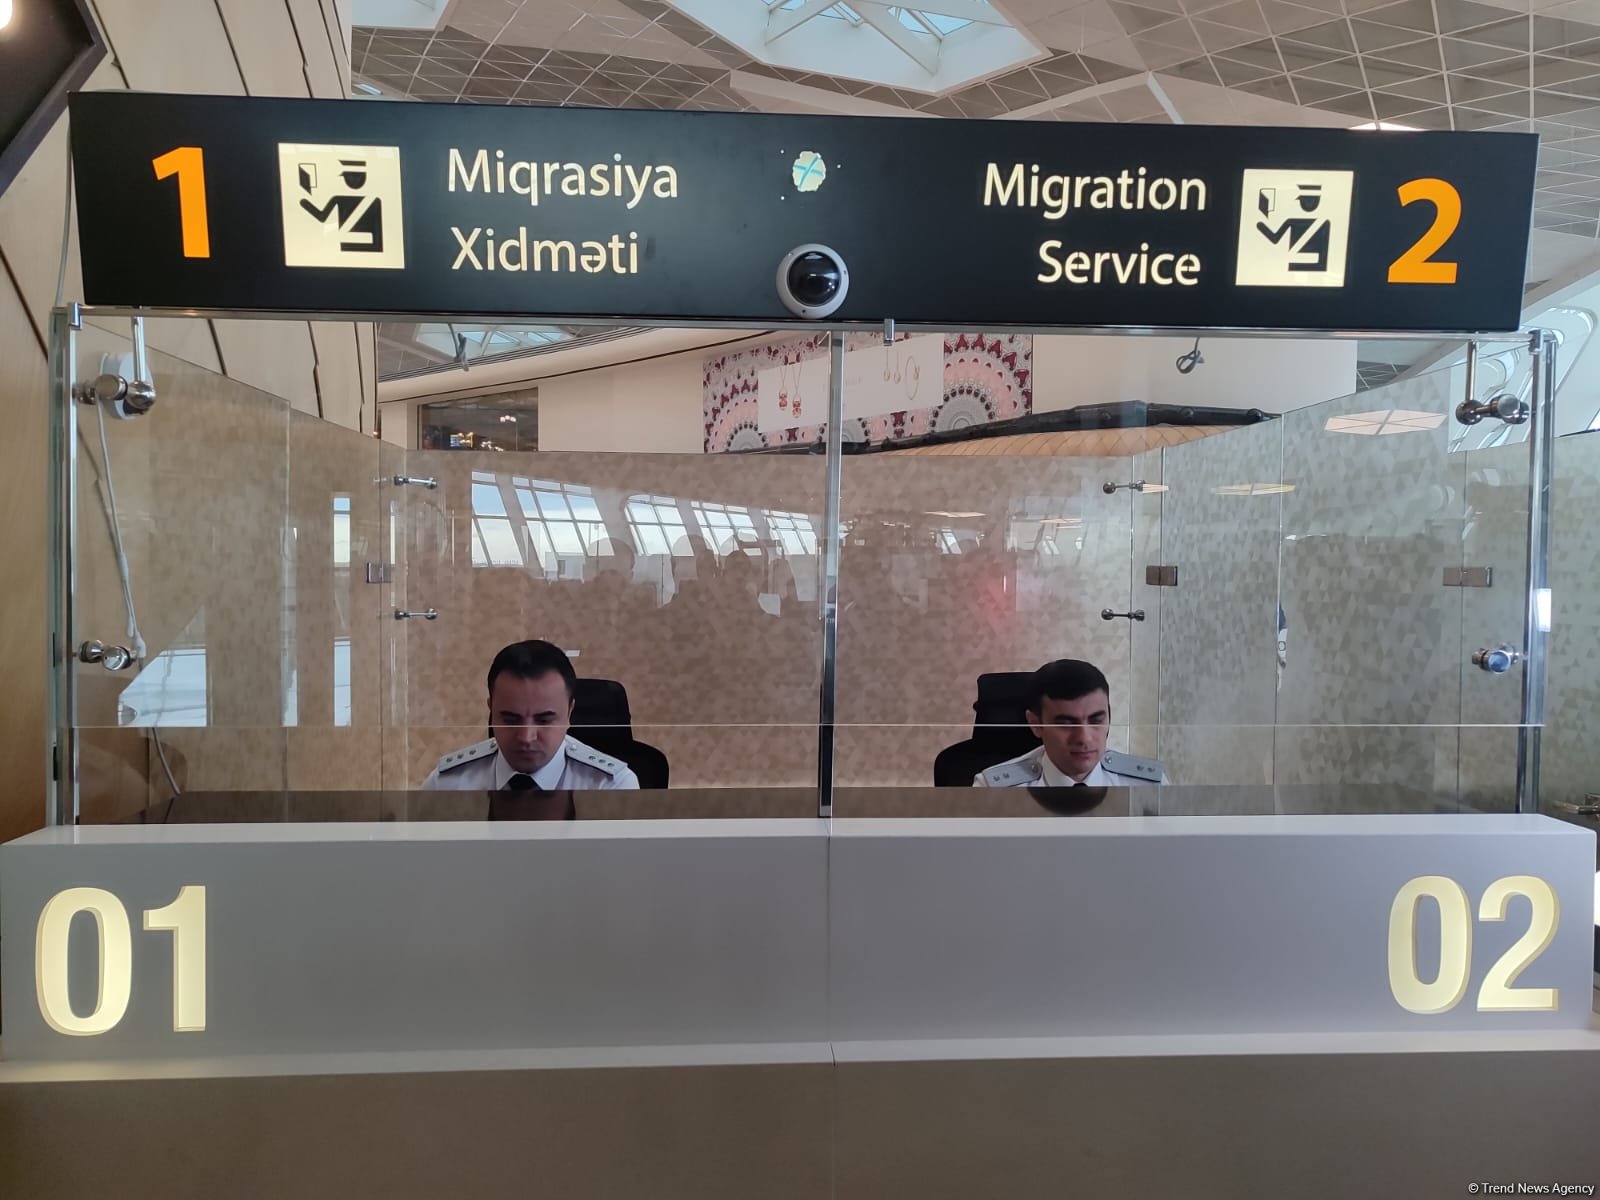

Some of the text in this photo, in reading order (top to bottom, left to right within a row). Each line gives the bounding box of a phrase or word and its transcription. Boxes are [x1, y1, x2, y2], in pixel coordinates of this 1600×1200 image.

[152, 147, 210, 258] 1
[448, 148, 678, 210] Miqrasiya
[984, 163, 1206, 220] Migration
[451, 226, 639, 275] Xidməti
[1037, 240, 1201, 286] Service
[1388, 178, 1461, 284] 2
[35, 885, 206, 1036] 01
[1388, 875, 1560, 1014] 02
